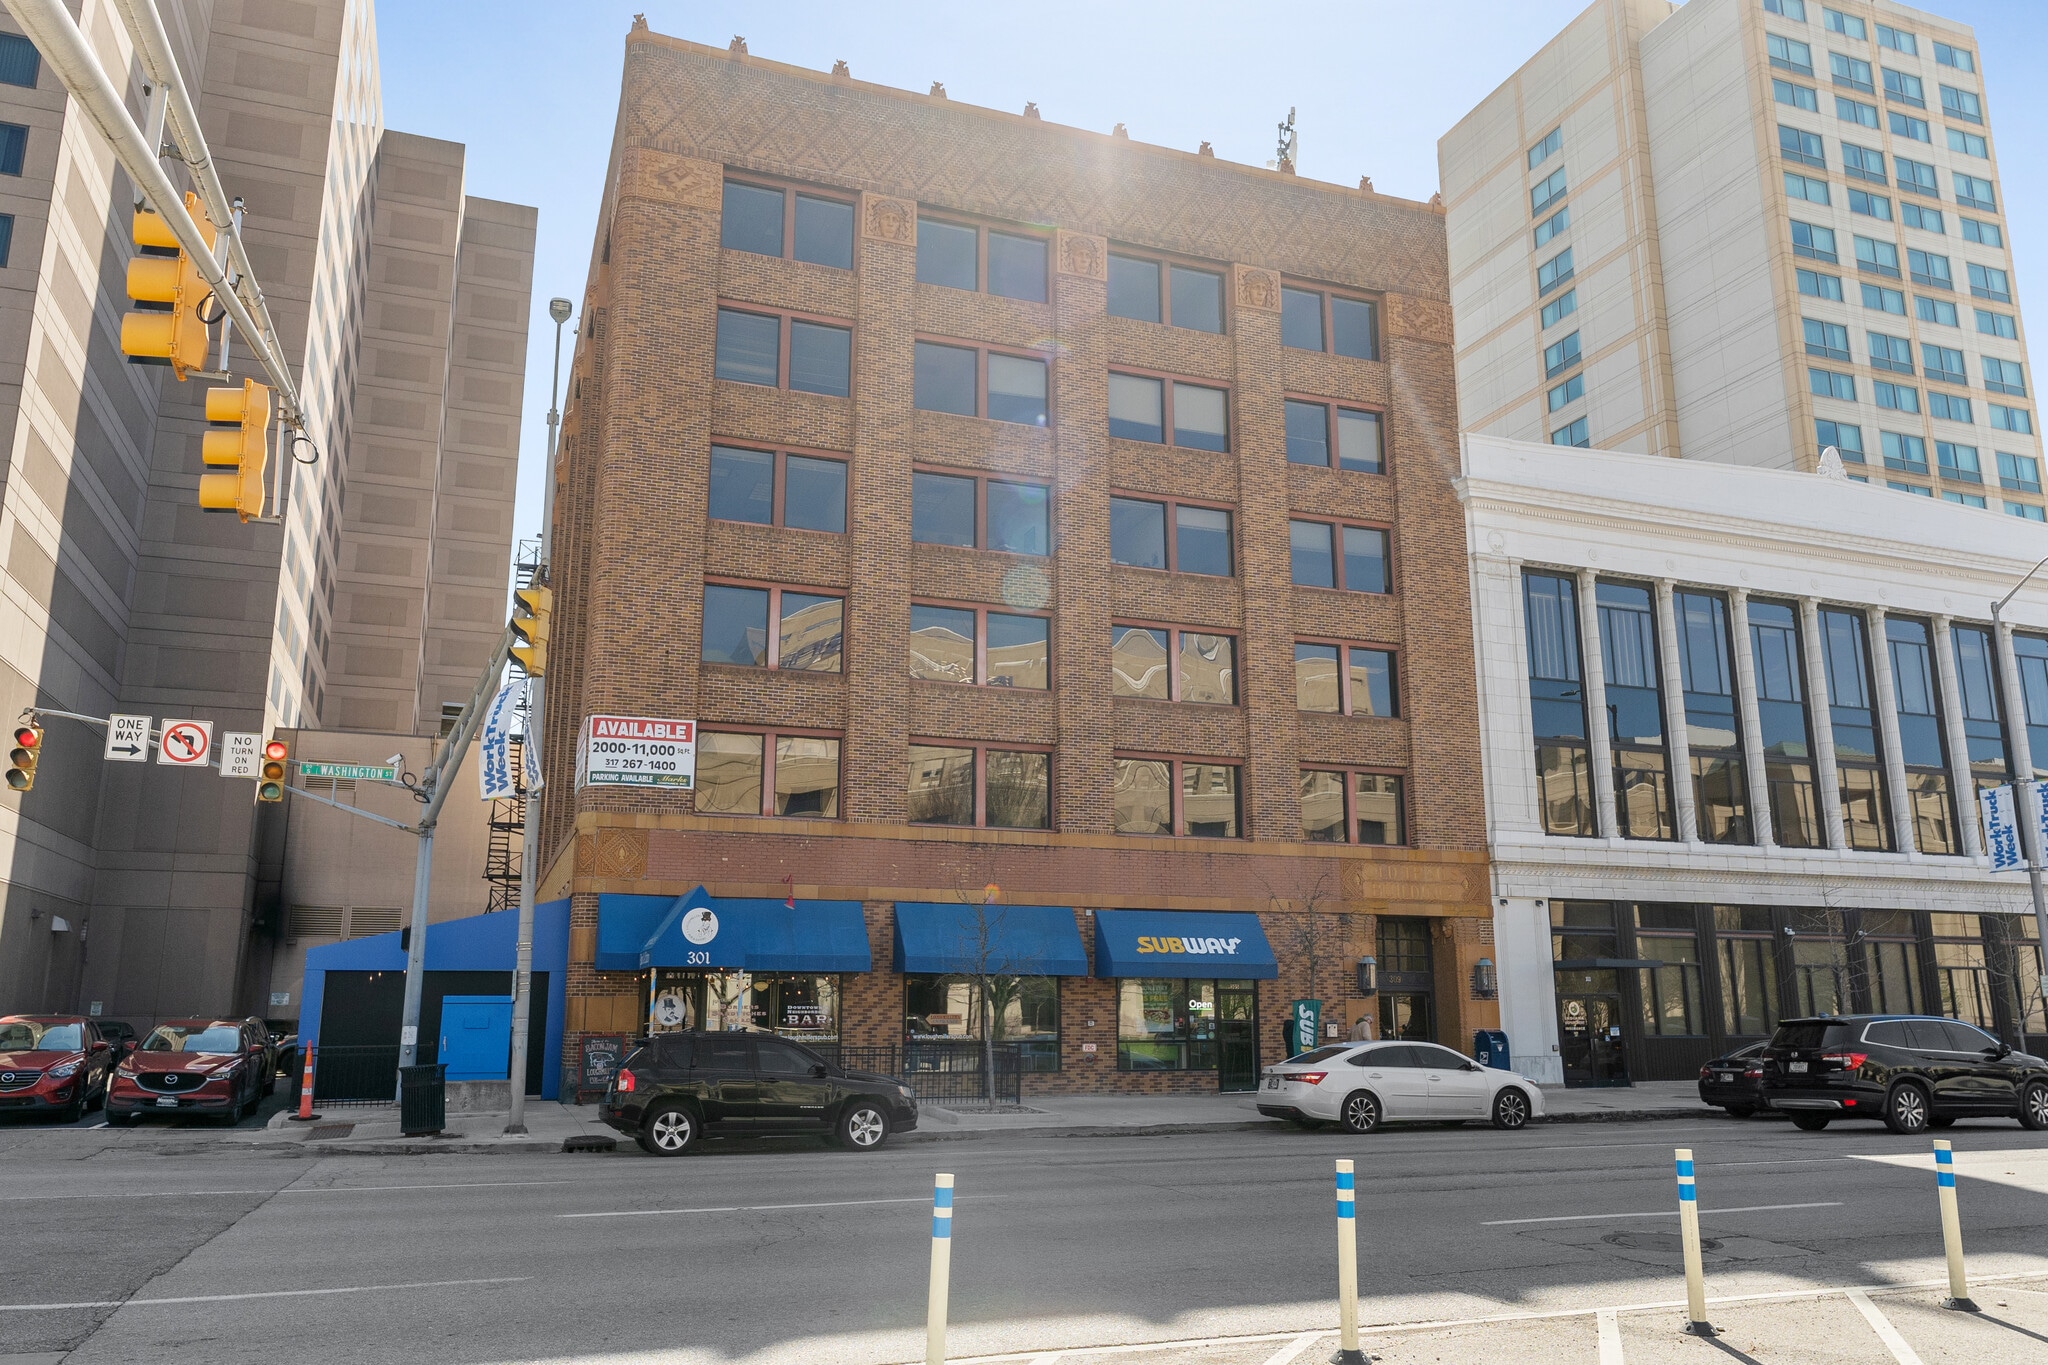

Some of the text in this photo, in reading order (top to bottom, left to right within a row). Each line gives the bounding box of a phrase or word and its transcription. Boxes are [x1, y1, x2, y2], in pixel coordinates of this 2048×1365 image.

[117, 718, 144, 730] ONE
[596, 720, 687, 740] AVAILABLE
[115, 730, 143, 742] WAY
[234, 737, 252, 746] NO
[230, 746, 254, 755] TURN
[592, 741, 676, 757] 2000-11,000
[234, 756, 248, 764] ON
[494, 729, 509, 792] Week
[605, 758, 676, 771] 317 267-1400
[231, 766, 249, 774] RED
[320, 765, 383, 779] WASHINGTON
[591, 773, 654, 783] PARKING AVAILABLE
[2001, 823, 2018, 867] Week
[1136, 936, 1241, 954] SUBWAY
[686, 951, 711, 965] 301
[1188, 999, 1213, 1010] Open
[787, 1014, 828, 1025] BAR
